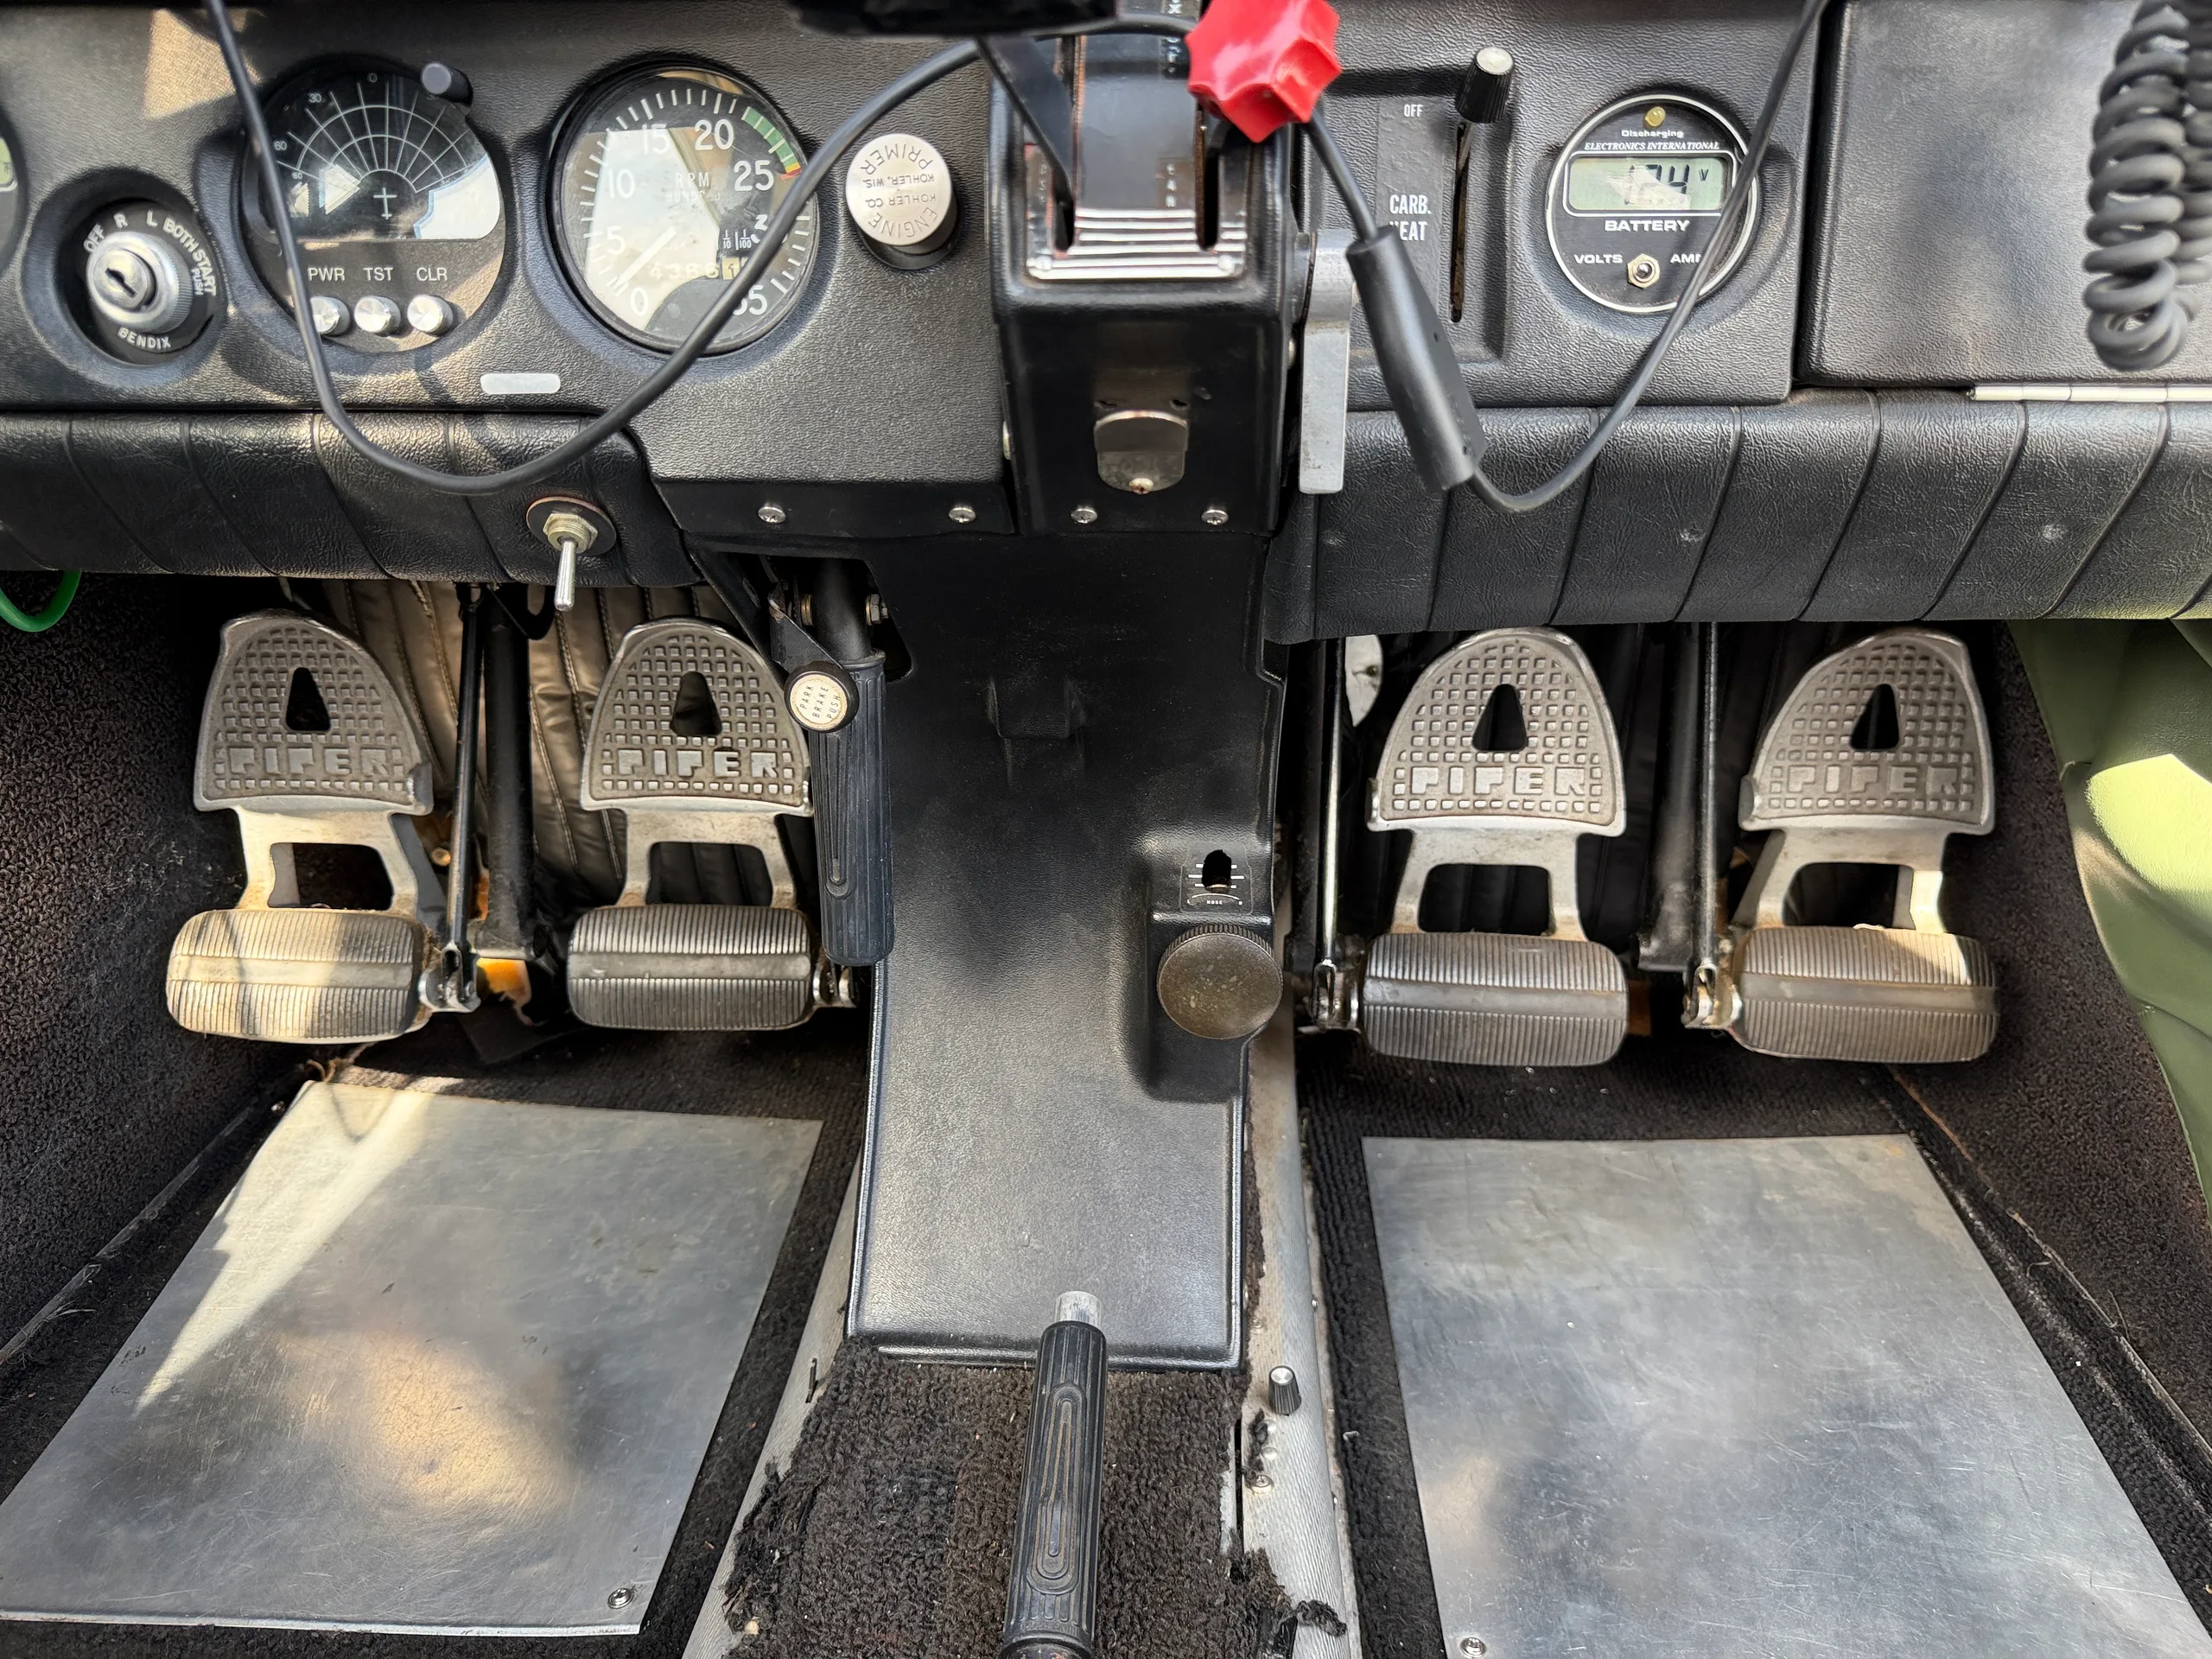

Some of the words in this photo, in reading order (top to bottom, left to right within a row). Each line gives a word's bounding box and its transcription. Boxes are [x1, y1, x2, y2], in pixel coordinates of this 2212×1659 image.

[308, 93, 322, 103] 30
[1403, 104, 1424, 118] OFF
[273, 141, 288, 150] 60
[641, 124, 671, 155] 15
[694, 118, 734, 150] 20
[1584, 142, 1645, 150] ELECTRONICS
[1646, 141, 1719, 150] INTERNATIONAL
[1621, 130, 1684, 138] Discharging
[861, 143, 933, 175] PRIMER
[608, 168, 635, 199] 10
[675, 171, 709, 188] RPM
[733, 160, 774, 192] 25
[888, 193, 936, 206] KOHLER
[1389, 194, 1432, 214] CARB.
[113, 213, 129, 229] R
[146, 210, 158, 227] L
[868, 207, 938, 238] ENGINE
[1389, 221, 1427, 241] EAT
[1605, 220, 1690, 232] BATTERY
[83, 223, 105, 252] OFF
[162, 217, 200, 252] BOTH
[606, 226, 626, 256] 5
[1573, 254, 1623, 264] VOLTS
[190, 268, 205, 296] PUSH
[192, 249, 216, 296] START
[308, 267, 345, 282] PWR
[363, 267, 394, 282] TST
[416, 267, 448, 282] CLR
[630, 286, 649, 316] 0
[118, 327, 171, 349] BENDIX
[799, 684, 814, 709] PARK
[812, 686, 829, 718] BRAKE
[826, 695, 841, 720] PUSH
[228, 747, 389, 776] PIPER
[617, 748, 778, 778] PIPER
[1410, 766, 1586, 797] PIPER
[1788, 765, 1959, 796] PIPER
